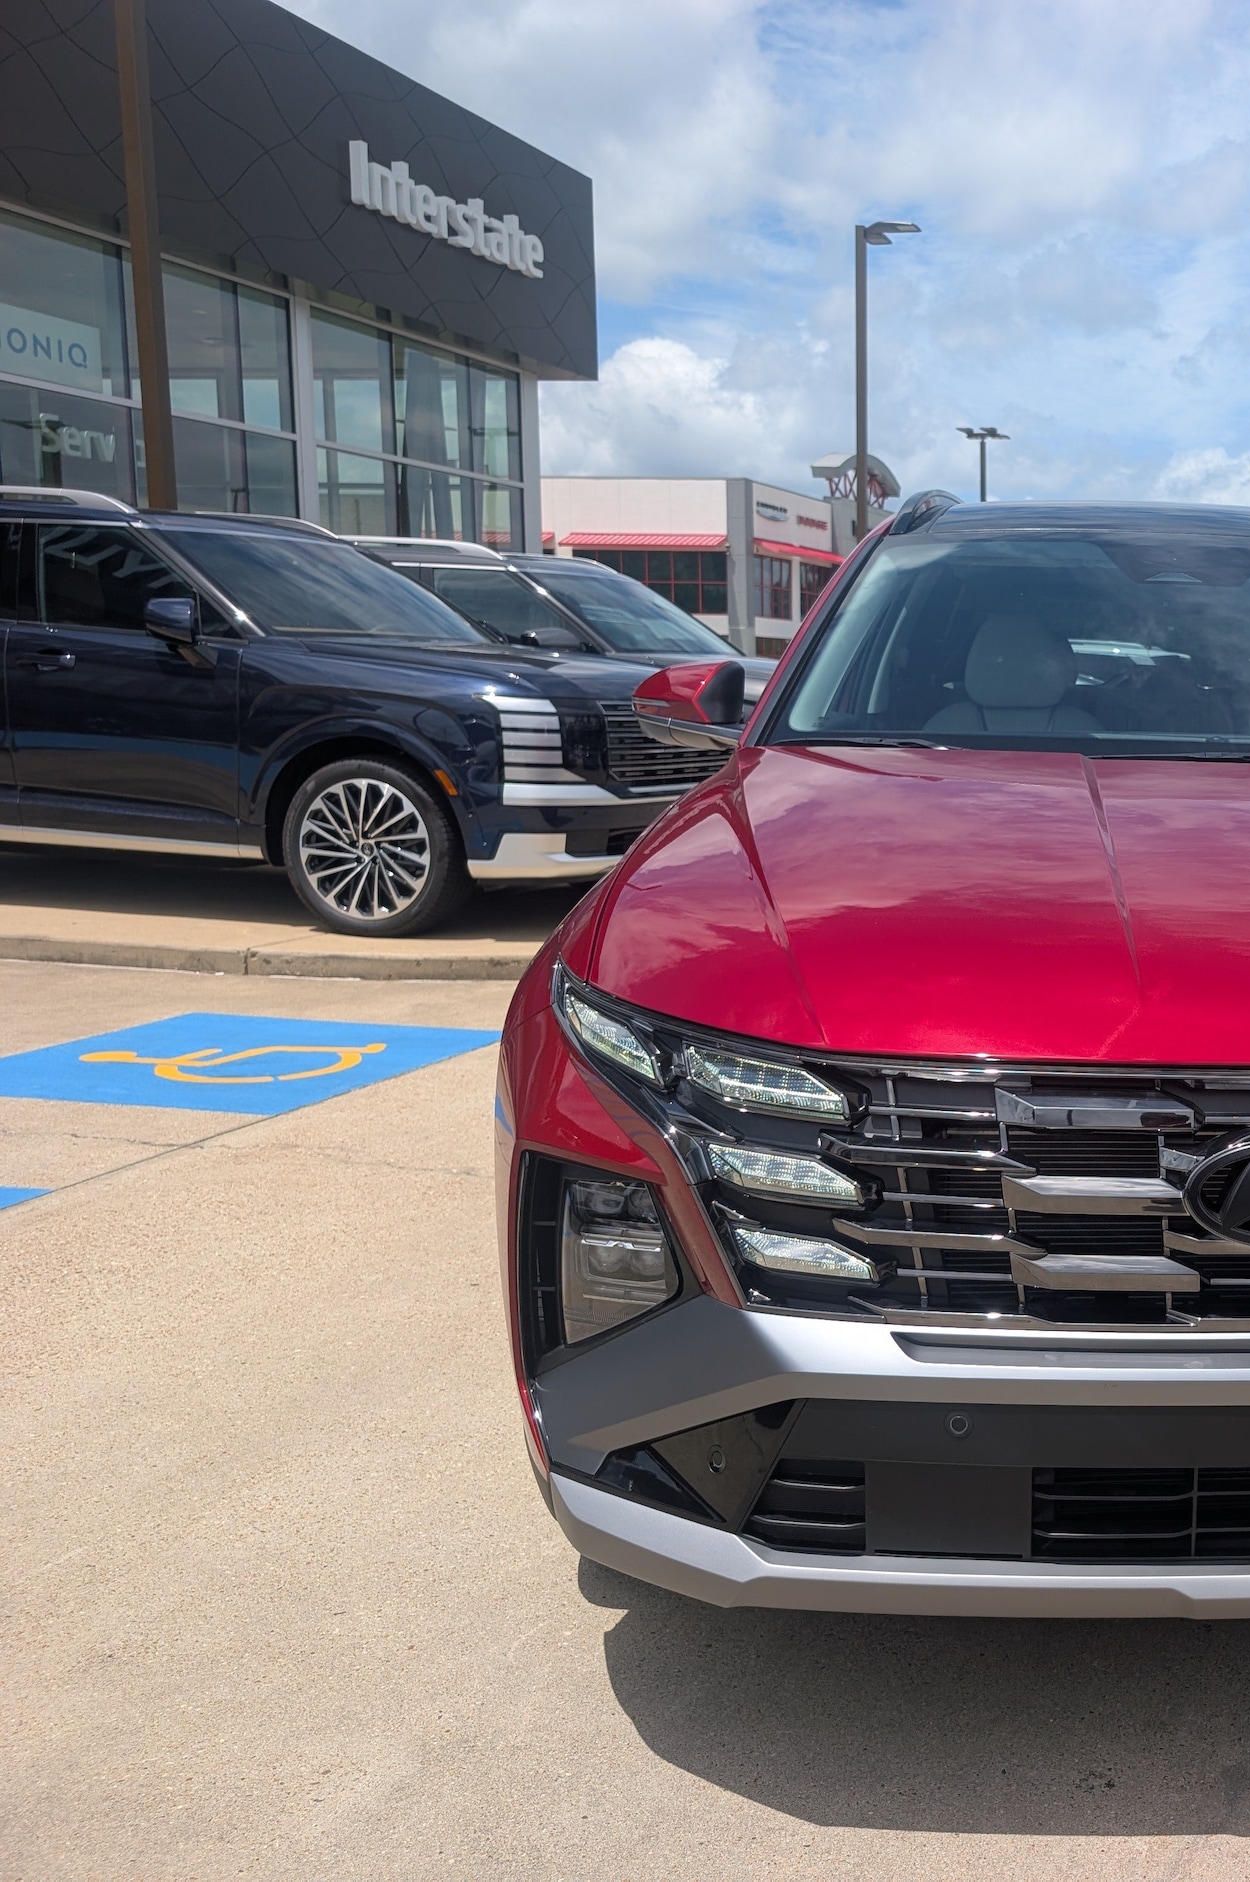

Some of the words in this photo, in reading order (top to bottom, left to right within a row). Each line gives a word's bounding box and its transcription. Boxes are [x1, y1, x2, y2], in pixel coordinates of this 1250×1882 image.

[349, 139, 545, 279] Interstate
[0, 327, 88, 369] ONIQ
[40, 412, 116, 463] Serv
